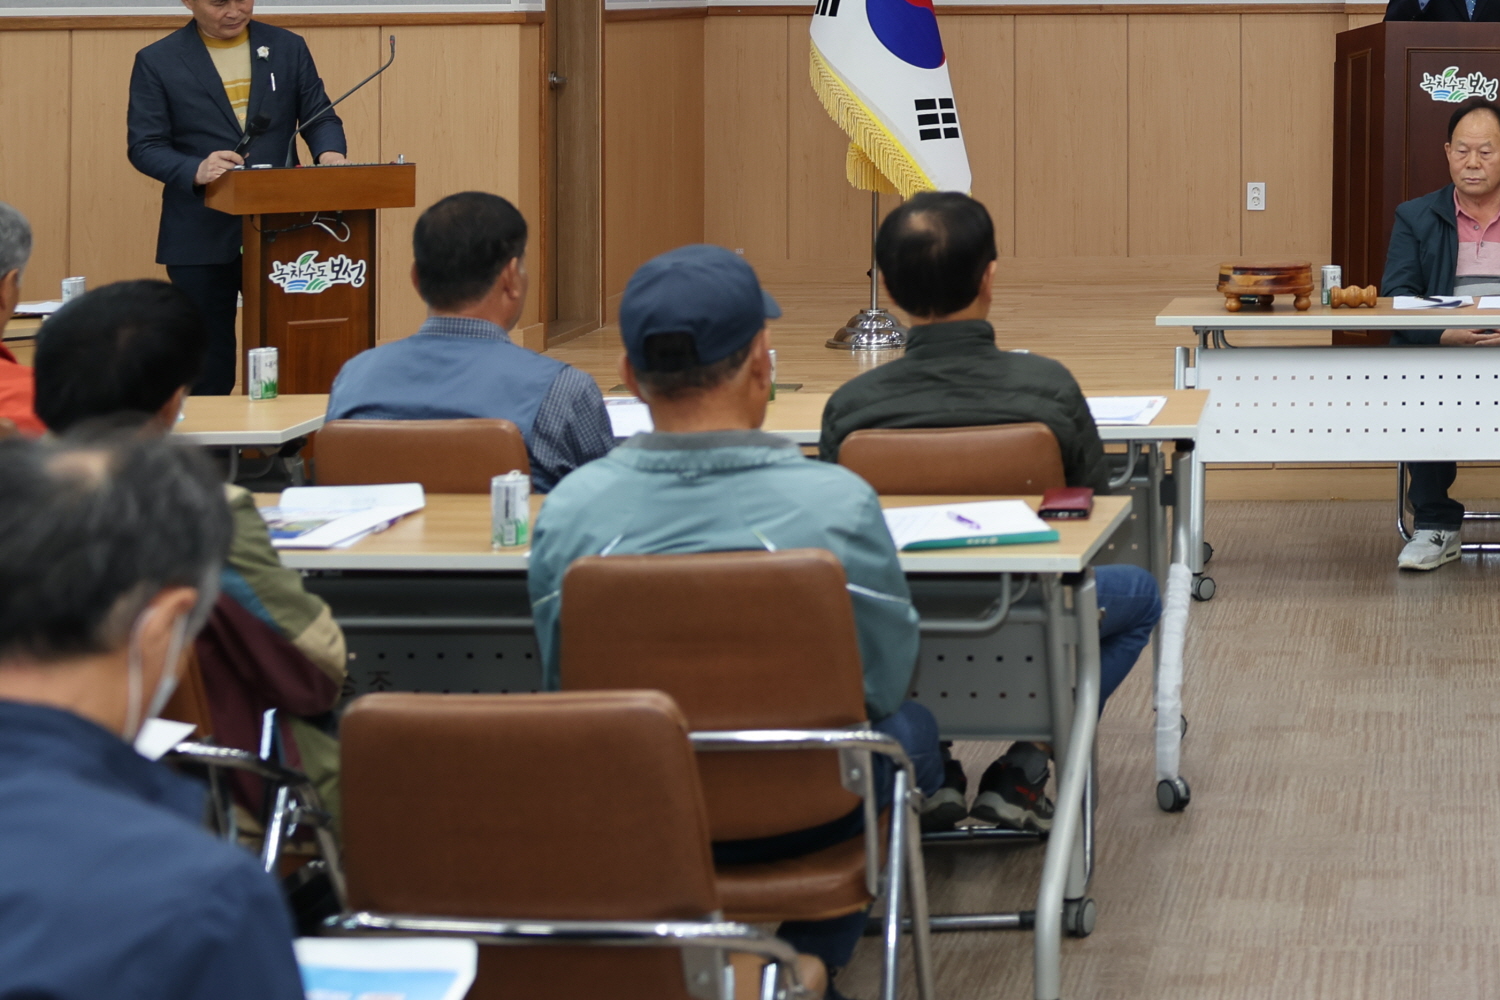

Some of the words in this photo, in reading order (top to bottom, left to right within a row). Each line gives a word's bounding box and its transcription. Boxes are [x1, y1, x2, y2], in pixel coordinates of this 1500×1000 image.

[1421, 73, 1467, 92] 녹차수도
[1468, 73, 1497, 100] 보성
[272, 261, 328, 284] 녹차수도
[329, 256, 364, 285] 보성
